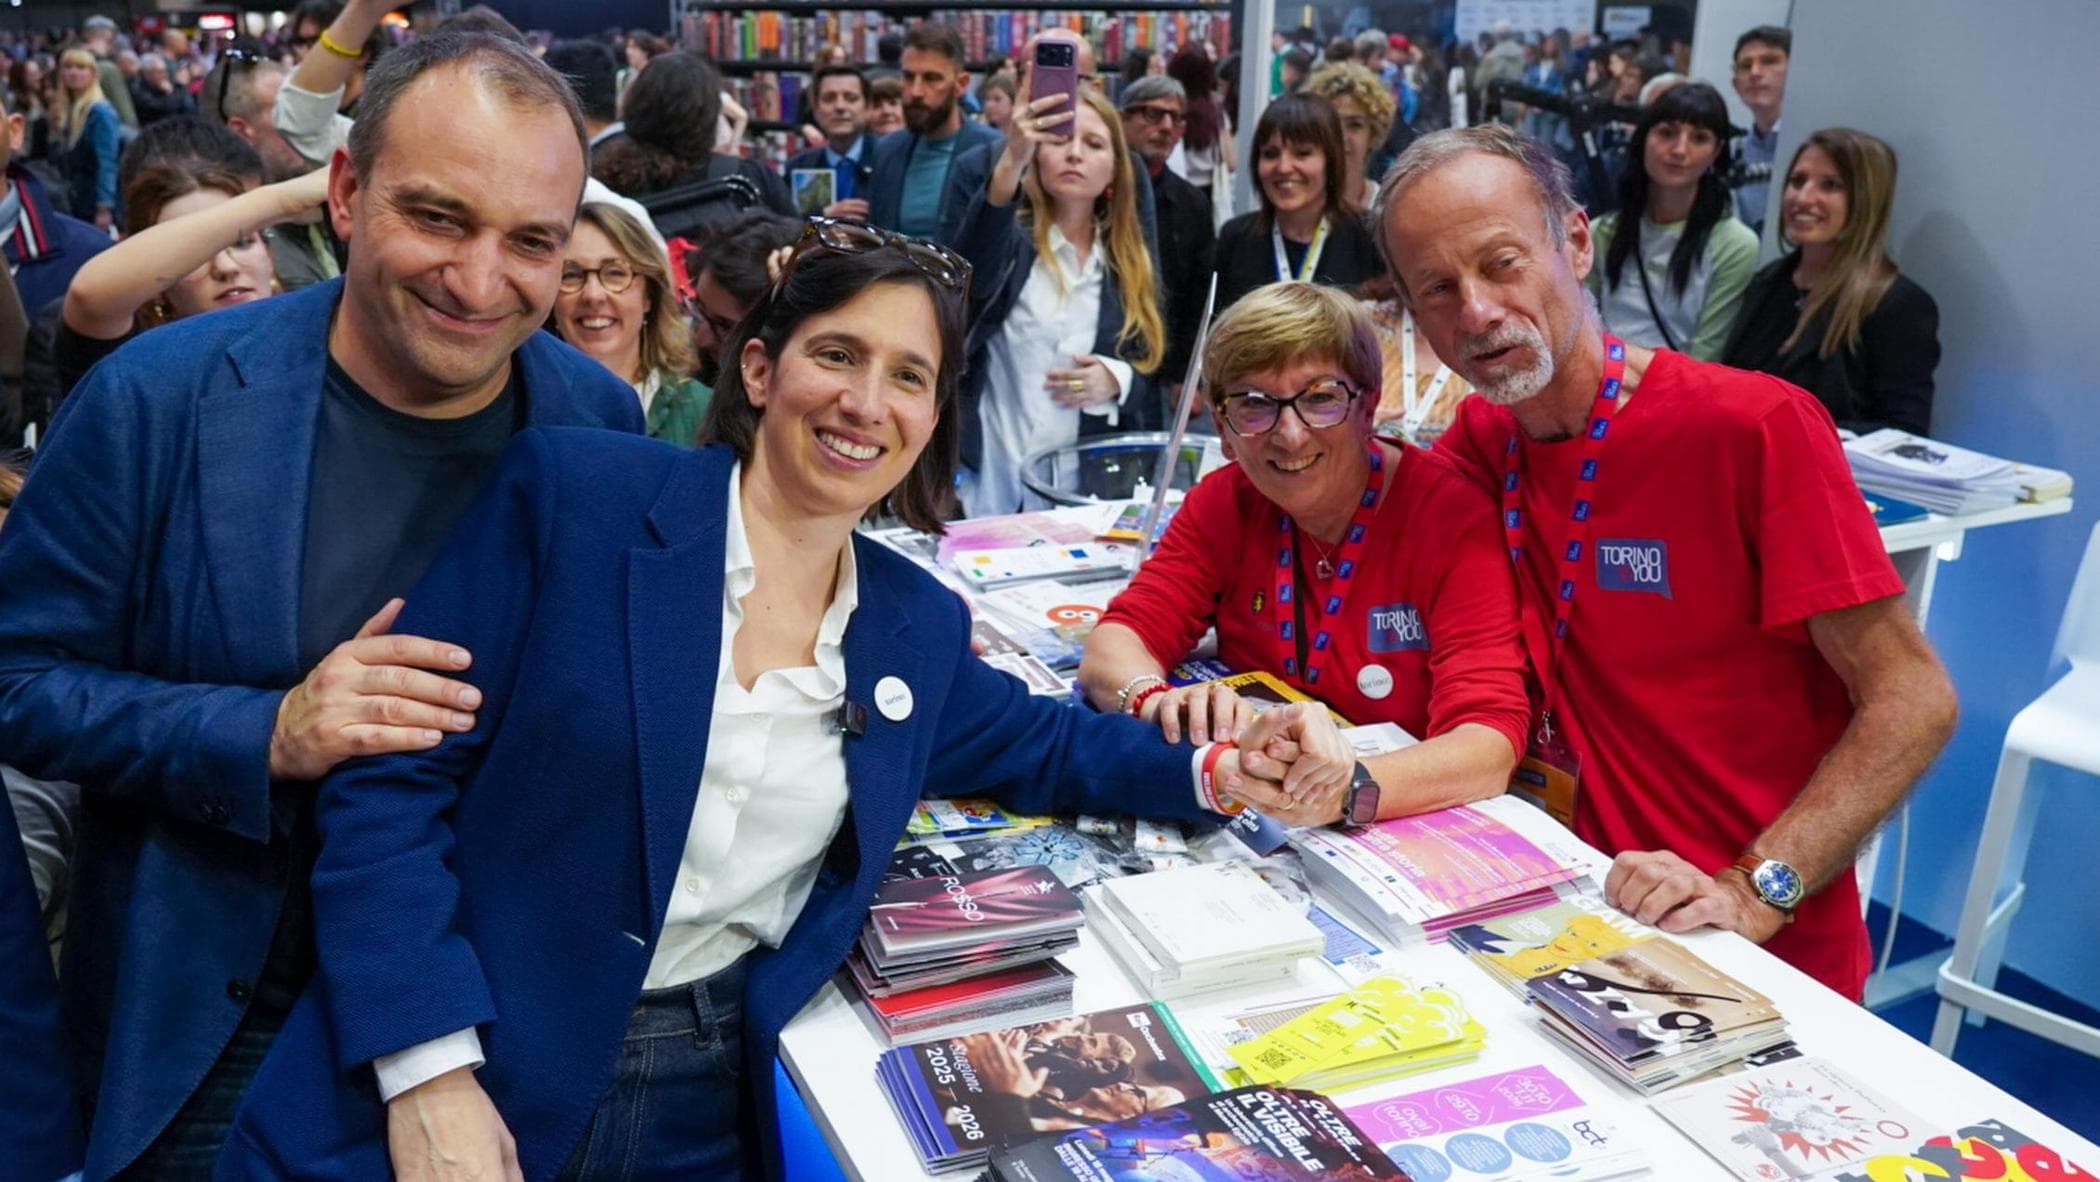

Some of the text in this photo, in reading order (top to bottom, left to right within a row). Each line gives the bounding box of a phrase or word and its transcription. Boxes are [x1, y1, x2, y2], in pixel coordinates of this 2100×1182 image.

[1600, 546, 1661, 567] TORINO
[1631, 564, 1662, 583] YOU
[939, 876, 985, 922] ROSSO
[926, 1047, 957, 1085] 2025
[952, 1105, 985, 1141] 2026
[1255, 1091, 1311, 1137] OLTRE
[1237, 1093, 1258, 1109] IL
[1253, 1111, 1326, 1172] VISIBILE
[1310, 1100, 1362, 1147] OLTRE
[1573, 1119, 1608, 1146] bct
